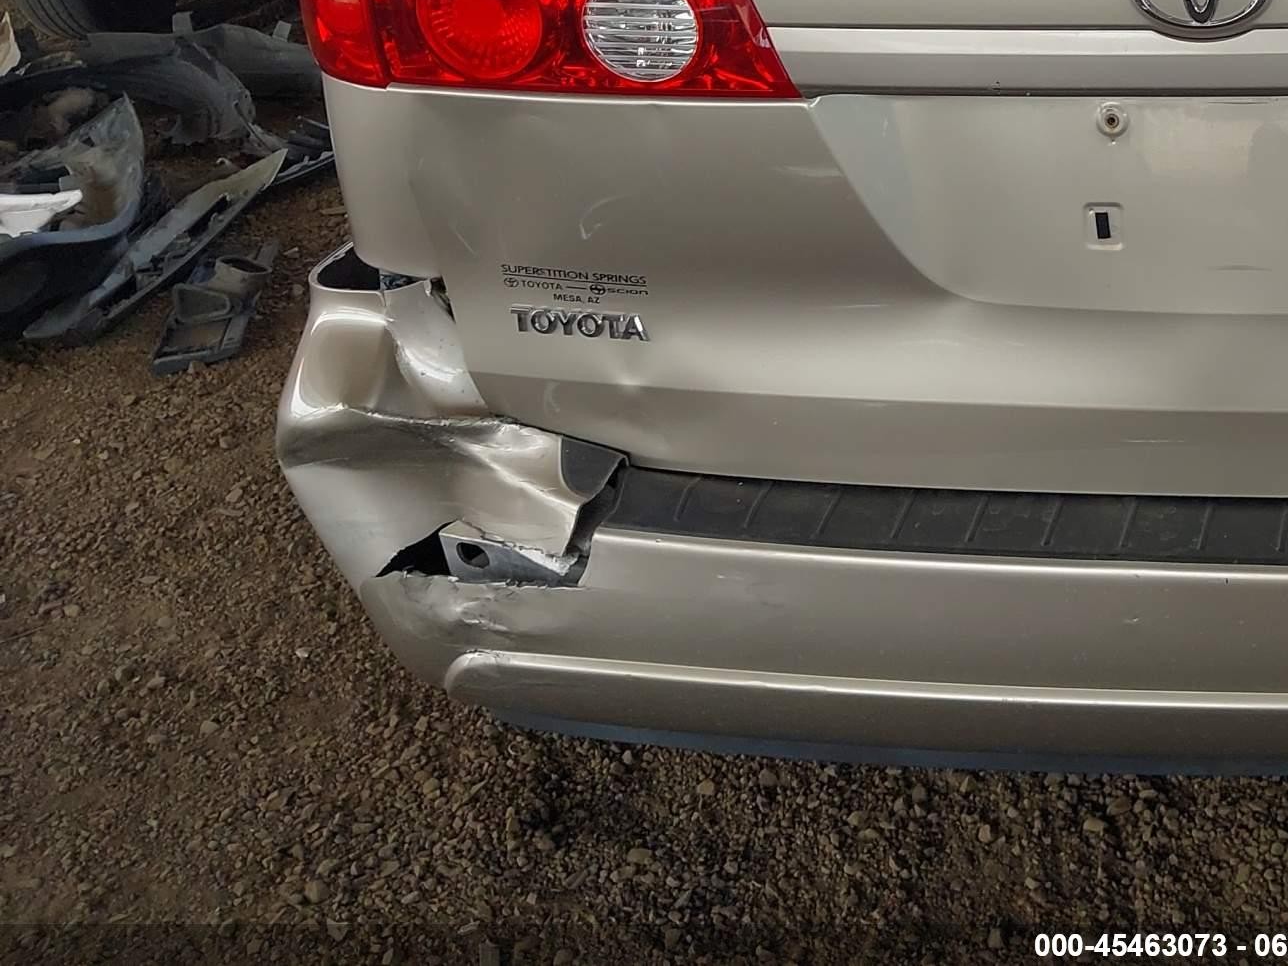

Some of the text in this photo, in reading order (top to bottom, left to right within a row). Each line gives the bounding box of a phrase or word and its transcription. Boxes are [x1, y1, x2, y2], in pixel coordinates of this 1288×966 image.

[500, 264, 647, 285] SUPERSTITION SPRINGS
[521, 280, 563, 291] TOYOTA
[587, 296, 601, 304] AZ
[510, 304, 650, 342] TOYOTA
